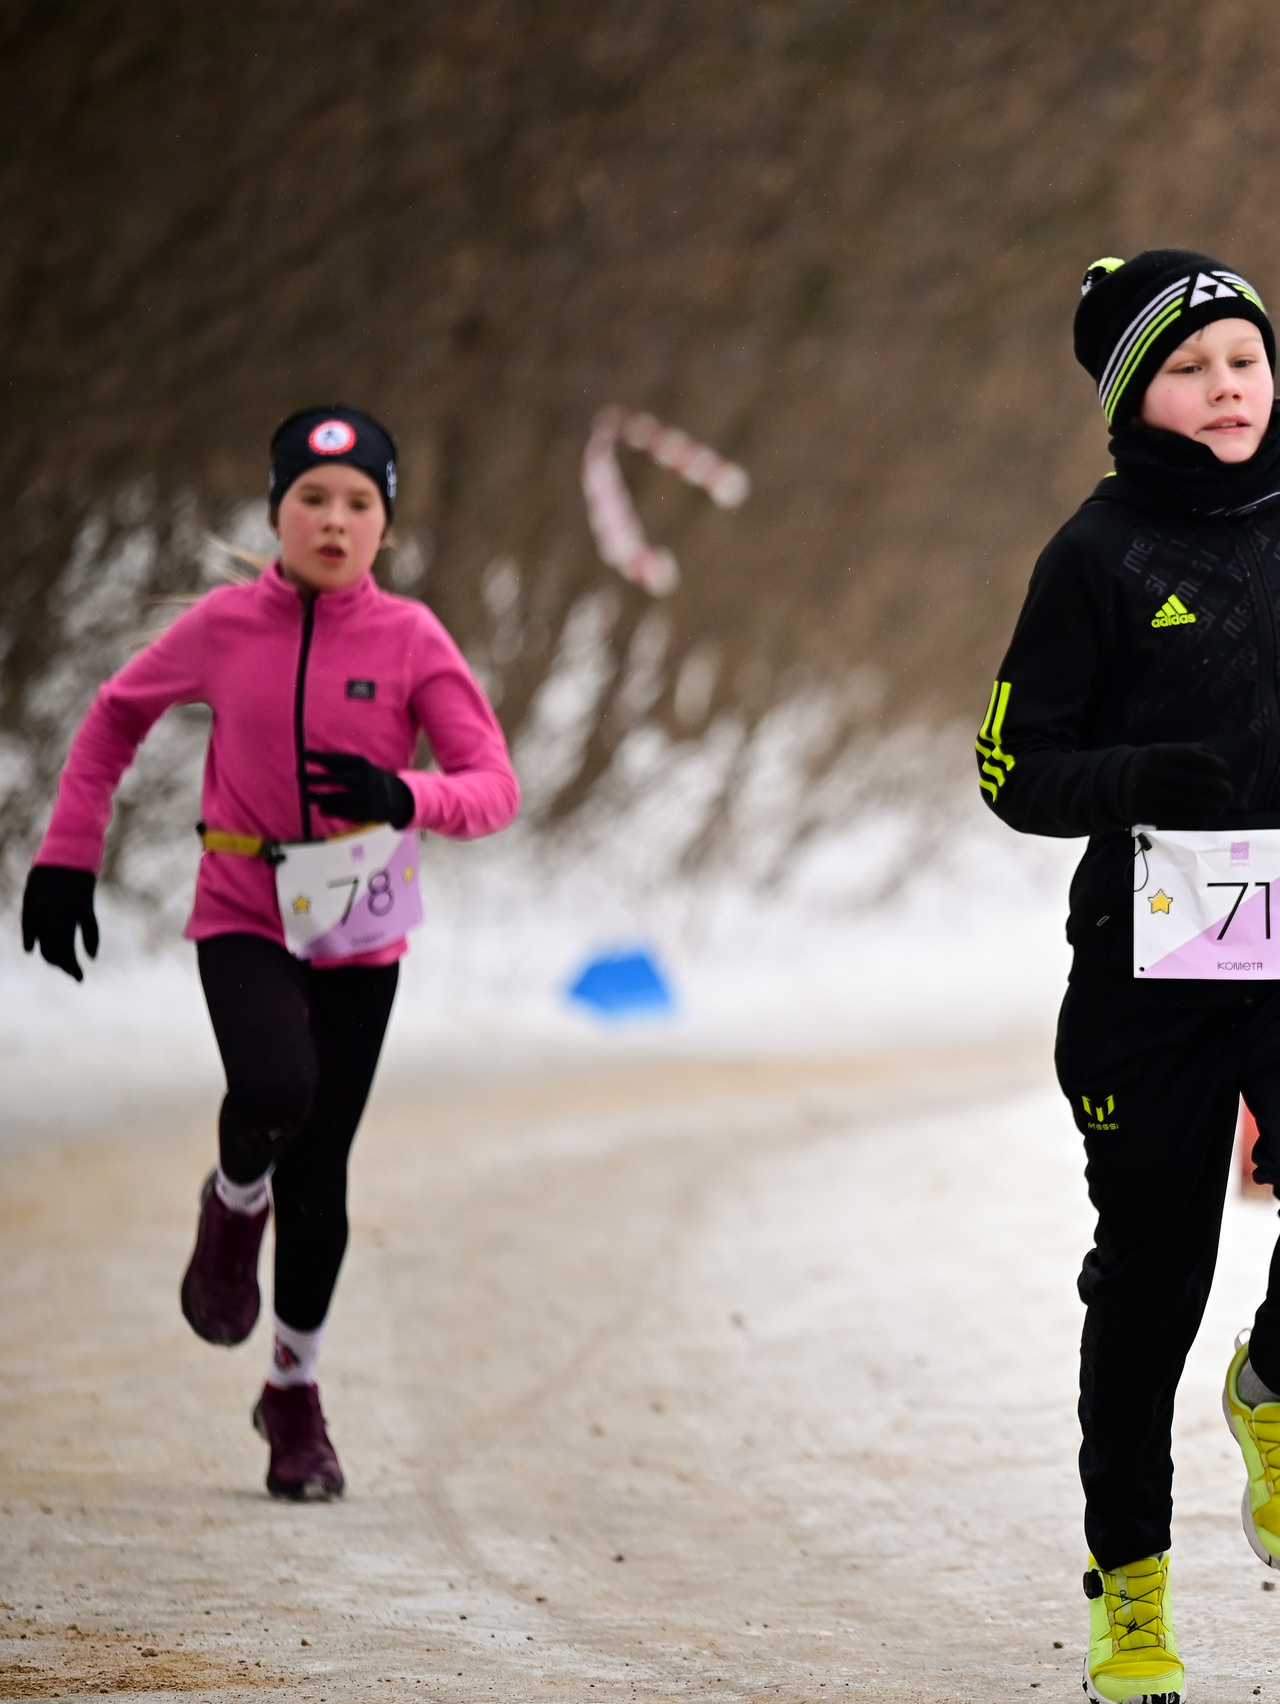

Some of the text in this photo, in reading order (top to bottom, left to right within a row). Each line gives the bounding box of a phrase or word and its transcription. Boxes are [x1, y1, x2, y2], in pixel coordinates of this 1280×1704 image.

[1151, 613, 1197, 628] adidas
[326, 869, 394, 927] 78
[1207, 881, 1271, 941] 71
